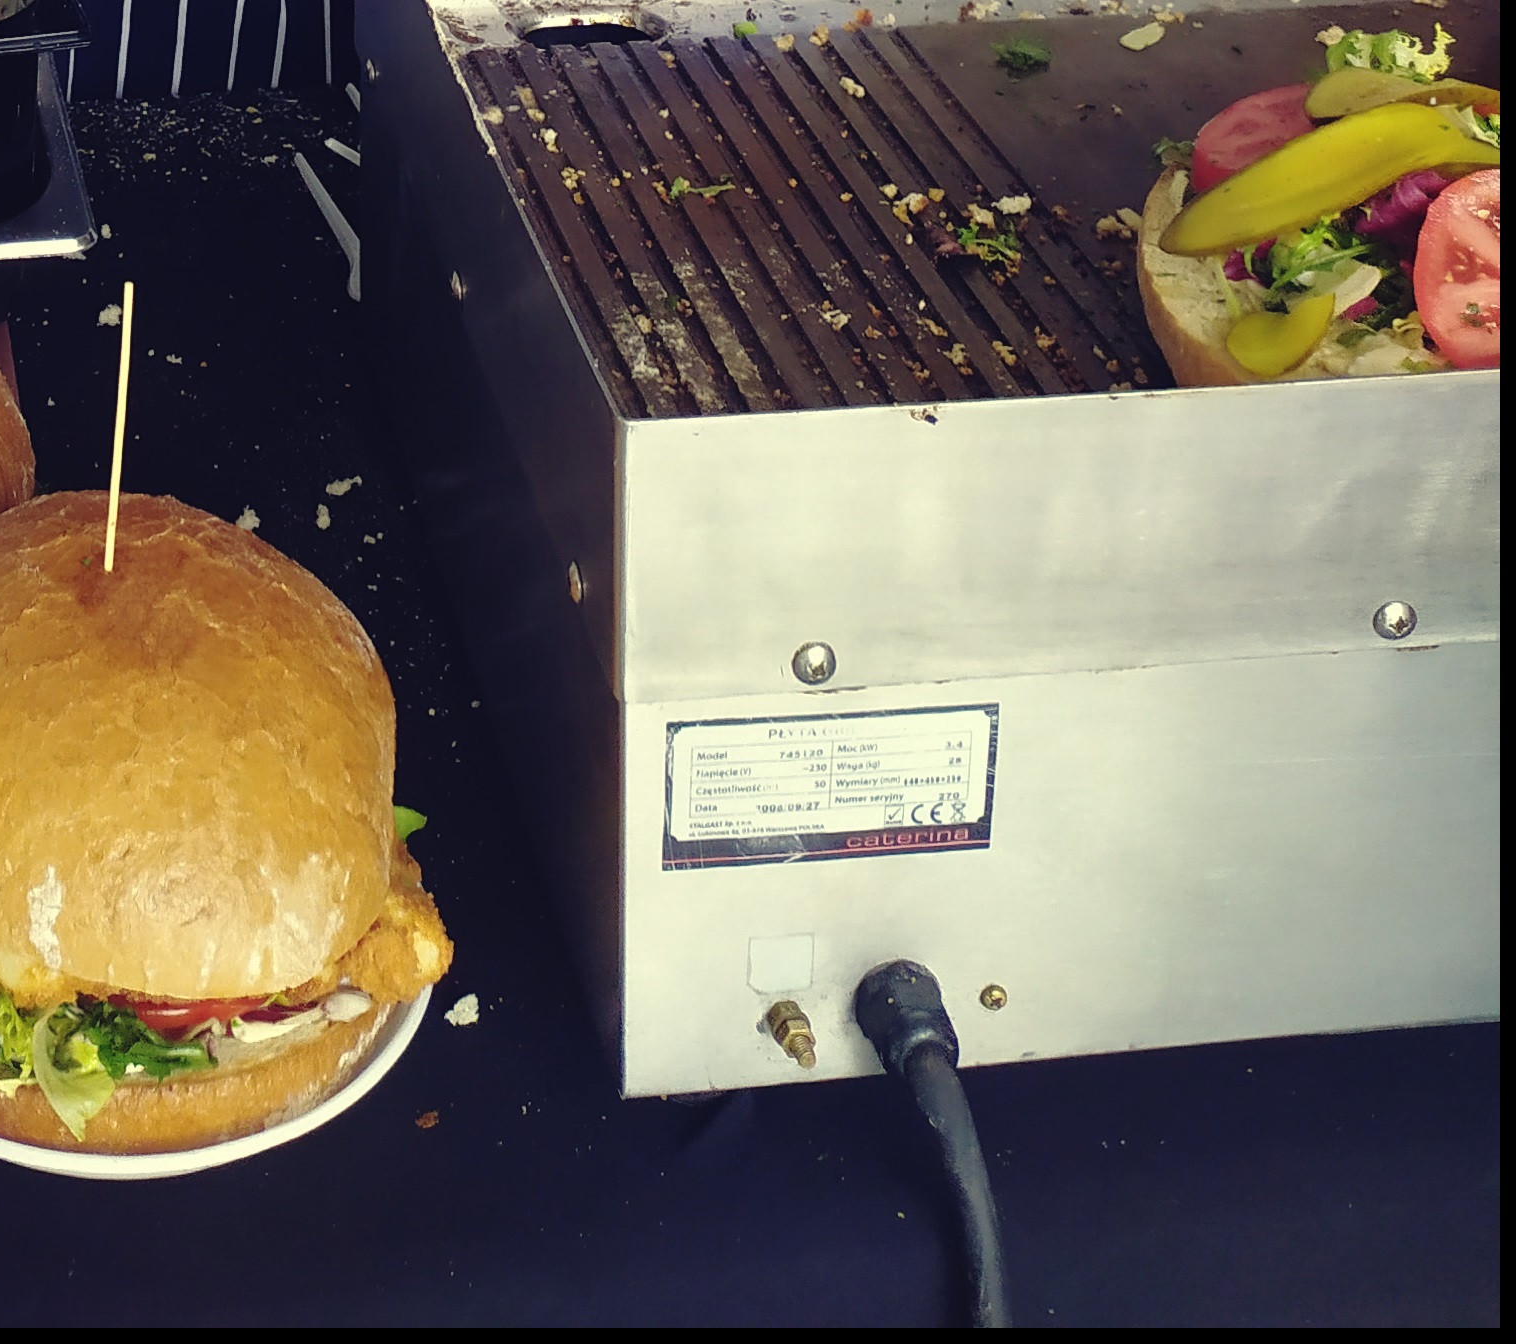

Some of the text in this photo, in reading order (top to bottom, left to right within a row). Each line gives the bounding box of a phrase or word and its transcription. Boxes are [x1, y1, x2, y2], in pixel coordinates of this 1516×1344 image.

[837, 744, 857, 753] Moc
[697, 751, 728, 760] Model
[836, 778, 878, 789] Wymiary
[834, 794, 867, 804] Numer
[870, 792, 904, 802] seryjny
[846, 827, 969, 848] caterina
